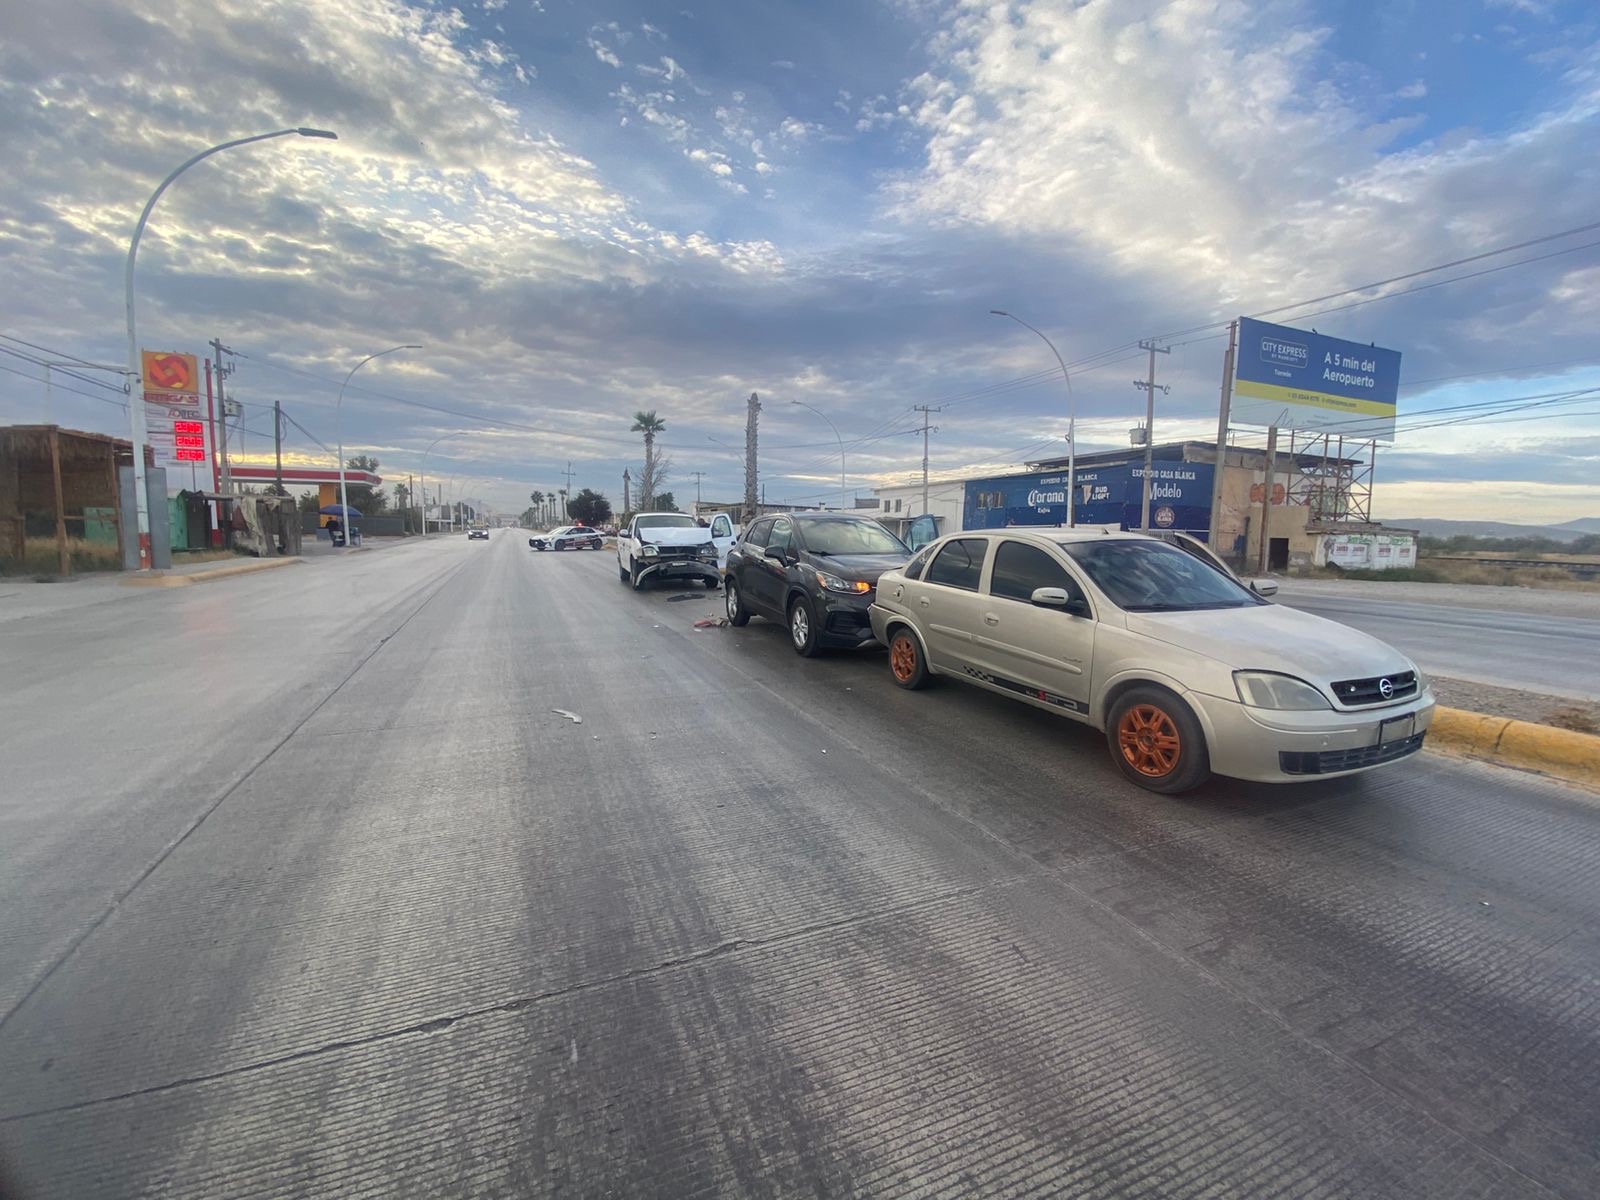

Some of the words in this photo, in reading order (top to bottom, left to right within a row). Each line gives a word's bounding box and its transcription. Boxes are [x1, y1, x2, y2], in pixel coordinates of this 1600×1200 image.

[1262, 341, 1278, 352] CITY
[1278, 344, 1307, 358] EXPRESS
[1324, 351, 1331, 364] A
[1334, 353, 1340, 366] 5
[1342, 356, 1359, 370] min
[1361, 359, 1376, 373] del
[1323, 367, 1375, 388] Aeropuerto
[1077, 474, 1098, 482] BLANCA
[1160, 470, 1174, 479] CASA
[1174, 471, 1196, 480] BLANCA
[1094, 485, 1108, 493] BUD
[1027, 489, 1065, 507] Corona
[1092, 492, 1110, 500] LIGHT
